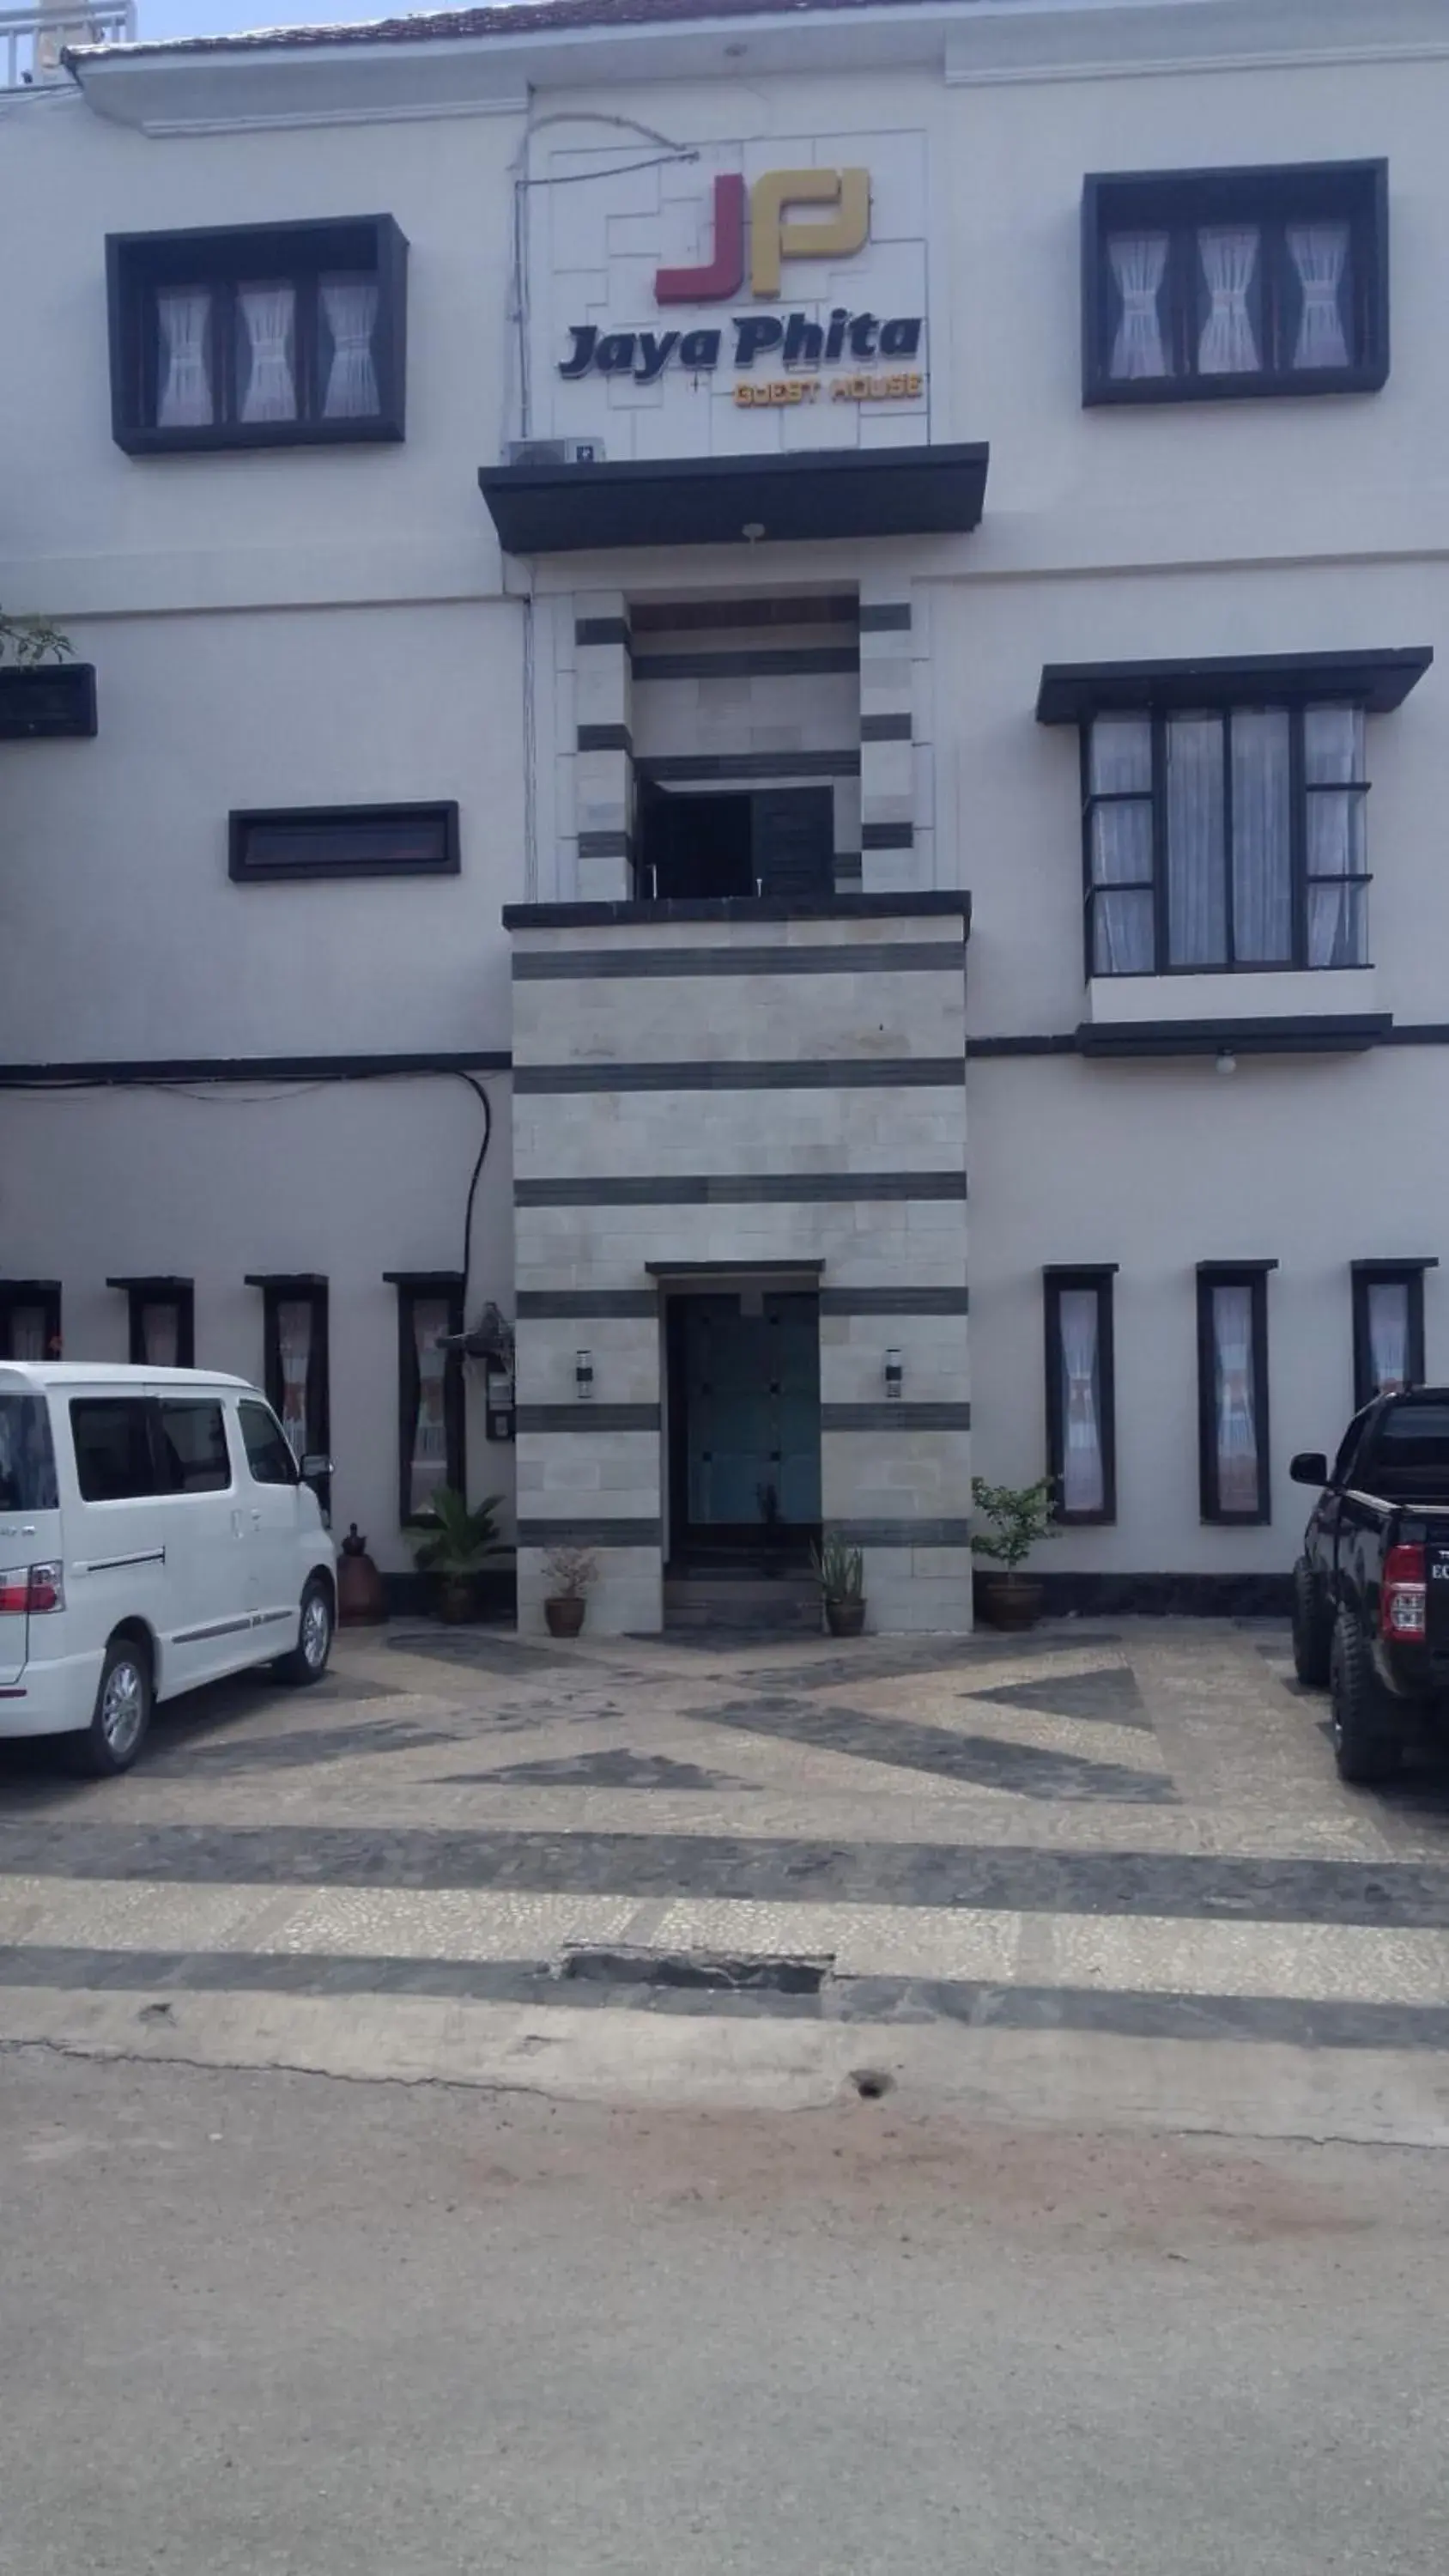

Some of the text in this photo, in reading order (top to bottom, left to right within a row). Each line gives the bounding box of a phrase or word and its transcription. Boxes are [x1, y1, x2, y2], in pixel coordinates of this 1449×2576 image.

[559, 307, 922, 385] Jaya Phita
[735, 372, 923, 408] GUEST HOUSE
